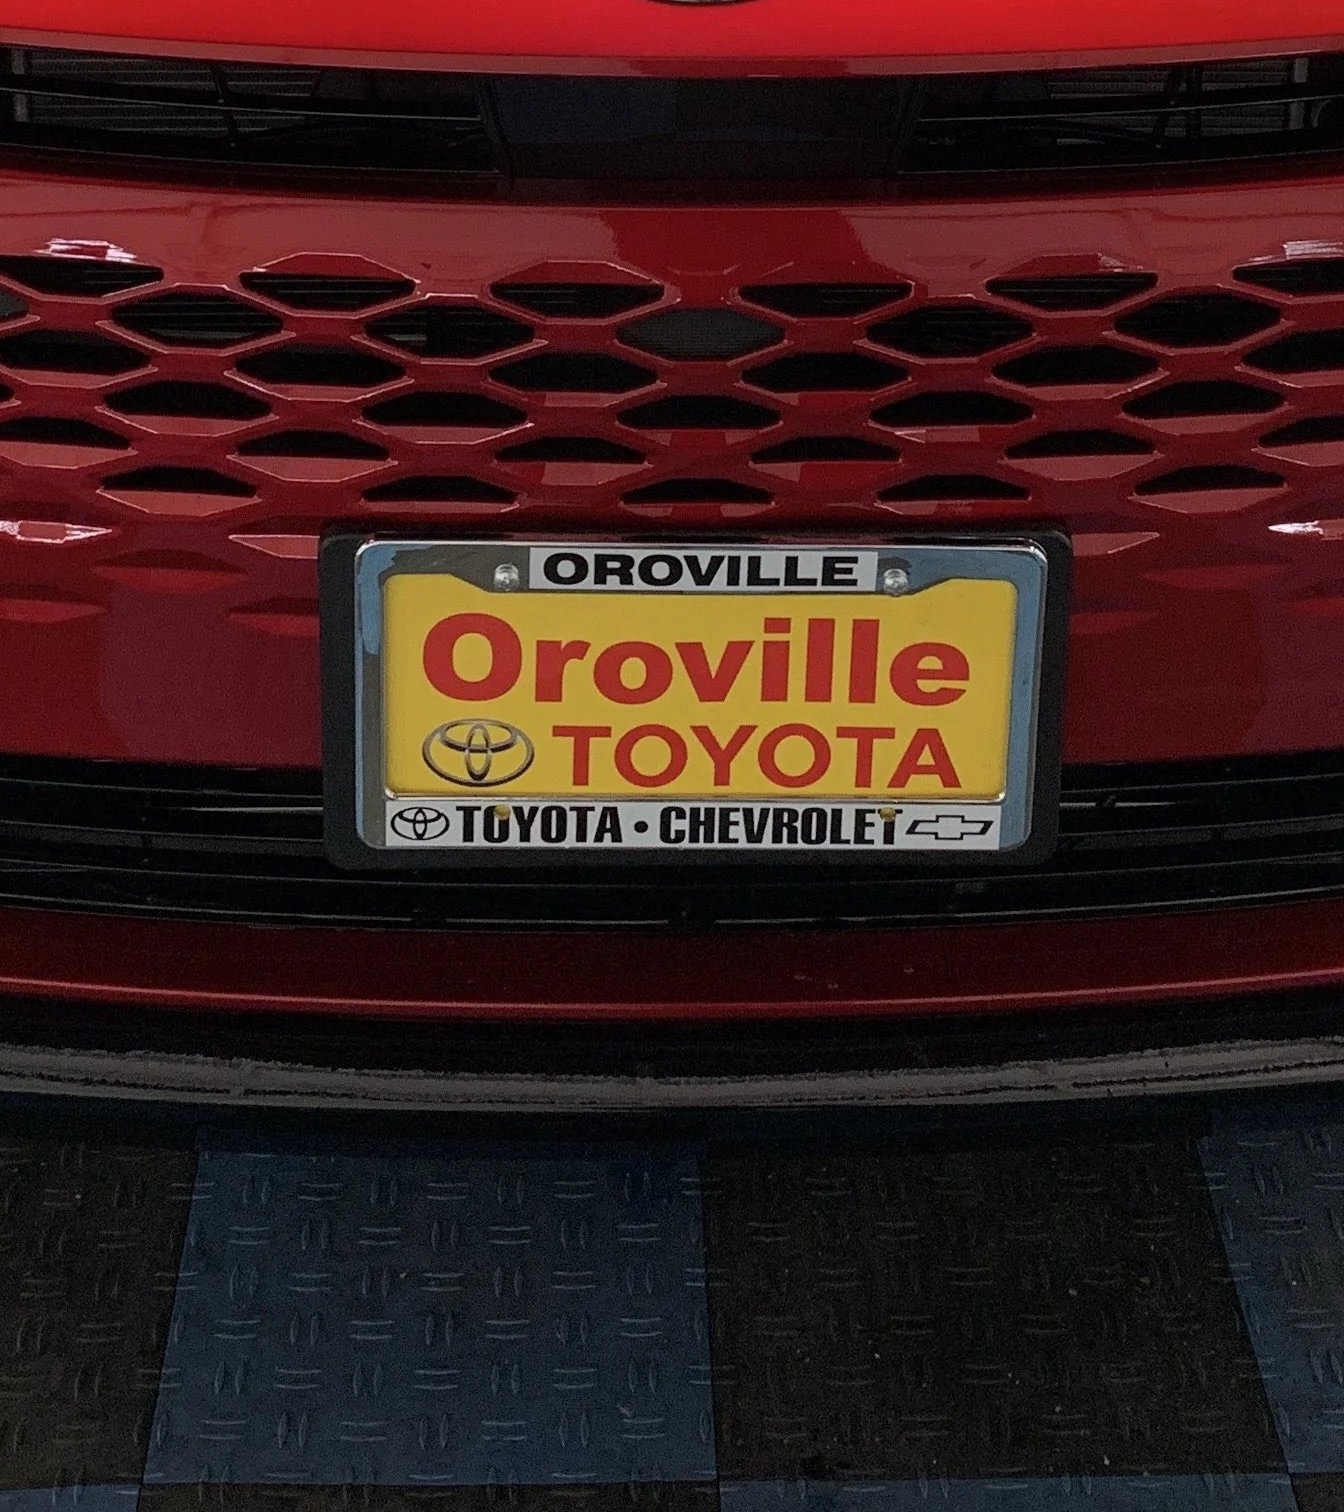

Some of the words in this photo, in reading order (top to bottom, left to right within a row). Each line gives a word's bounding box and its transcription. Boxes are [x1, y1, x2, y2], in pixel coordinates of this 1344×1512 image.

[543, 552, 858, 587] OROVILLE
[422, 612, 971, 705] Oroville
[552, 724, 963, 789] TOYOTA
[457, 805, 623, 844] TOYOTA
[659, 806, 903, 846] CHEVROLET
